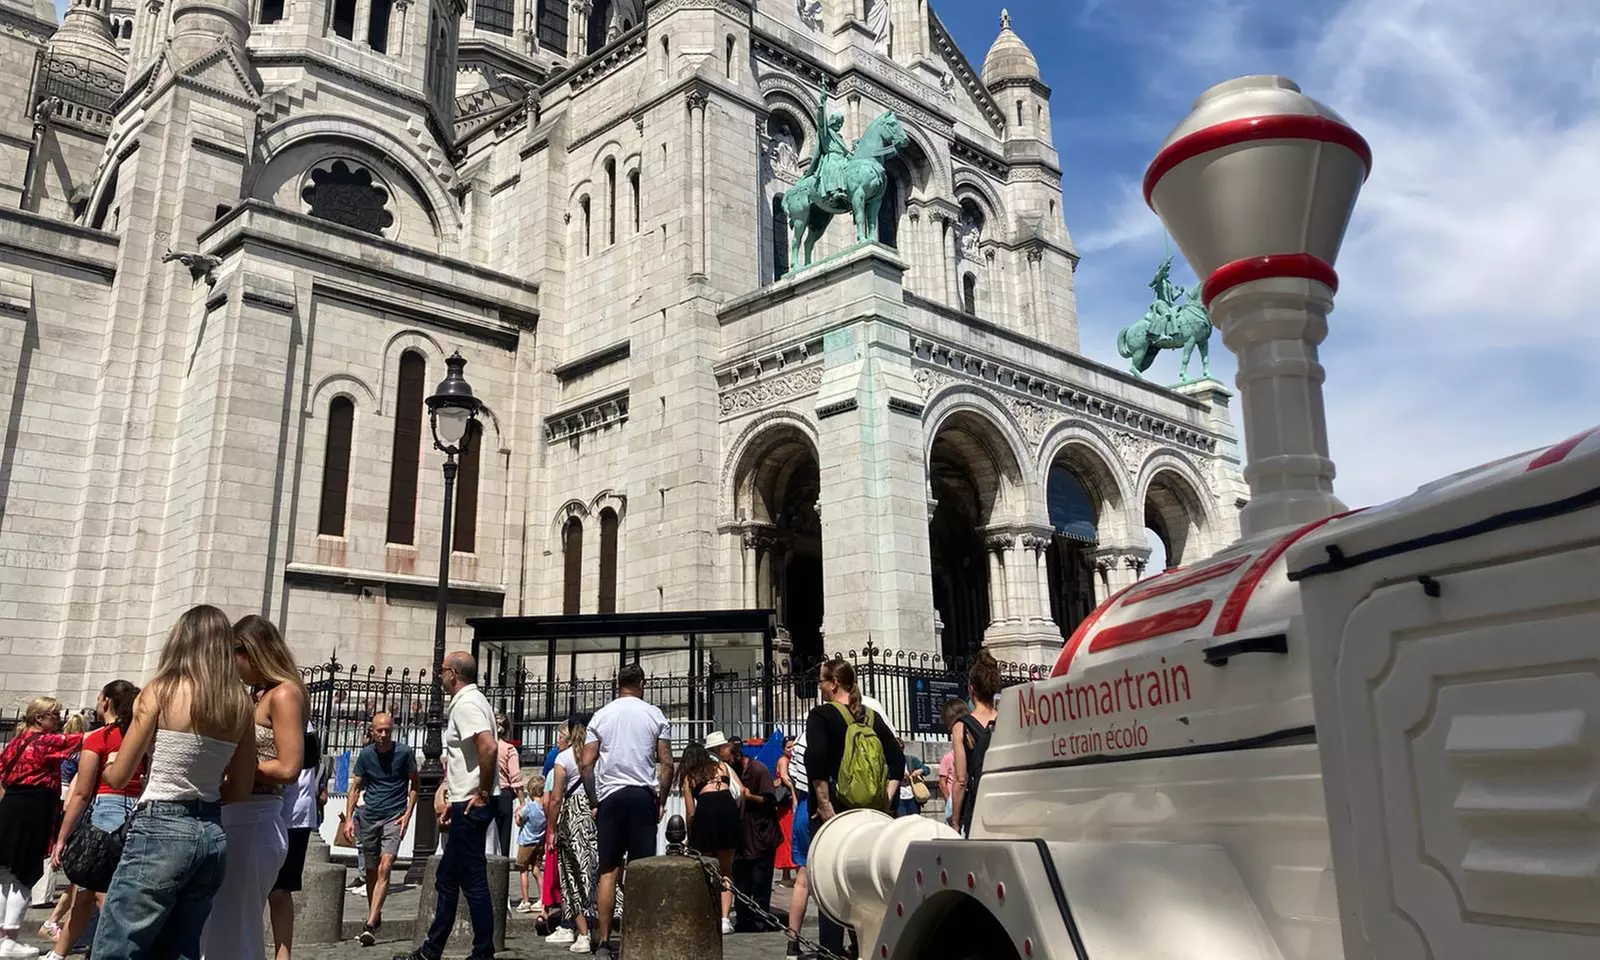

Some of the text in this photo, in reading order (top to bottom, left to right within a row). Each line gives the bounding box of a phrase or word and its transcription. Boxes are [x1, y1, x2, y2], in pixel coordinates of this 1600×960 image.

[1018, 657, 1191, 728] Montmartrain
[1051, 720, 1148, 757] Le train écolo
